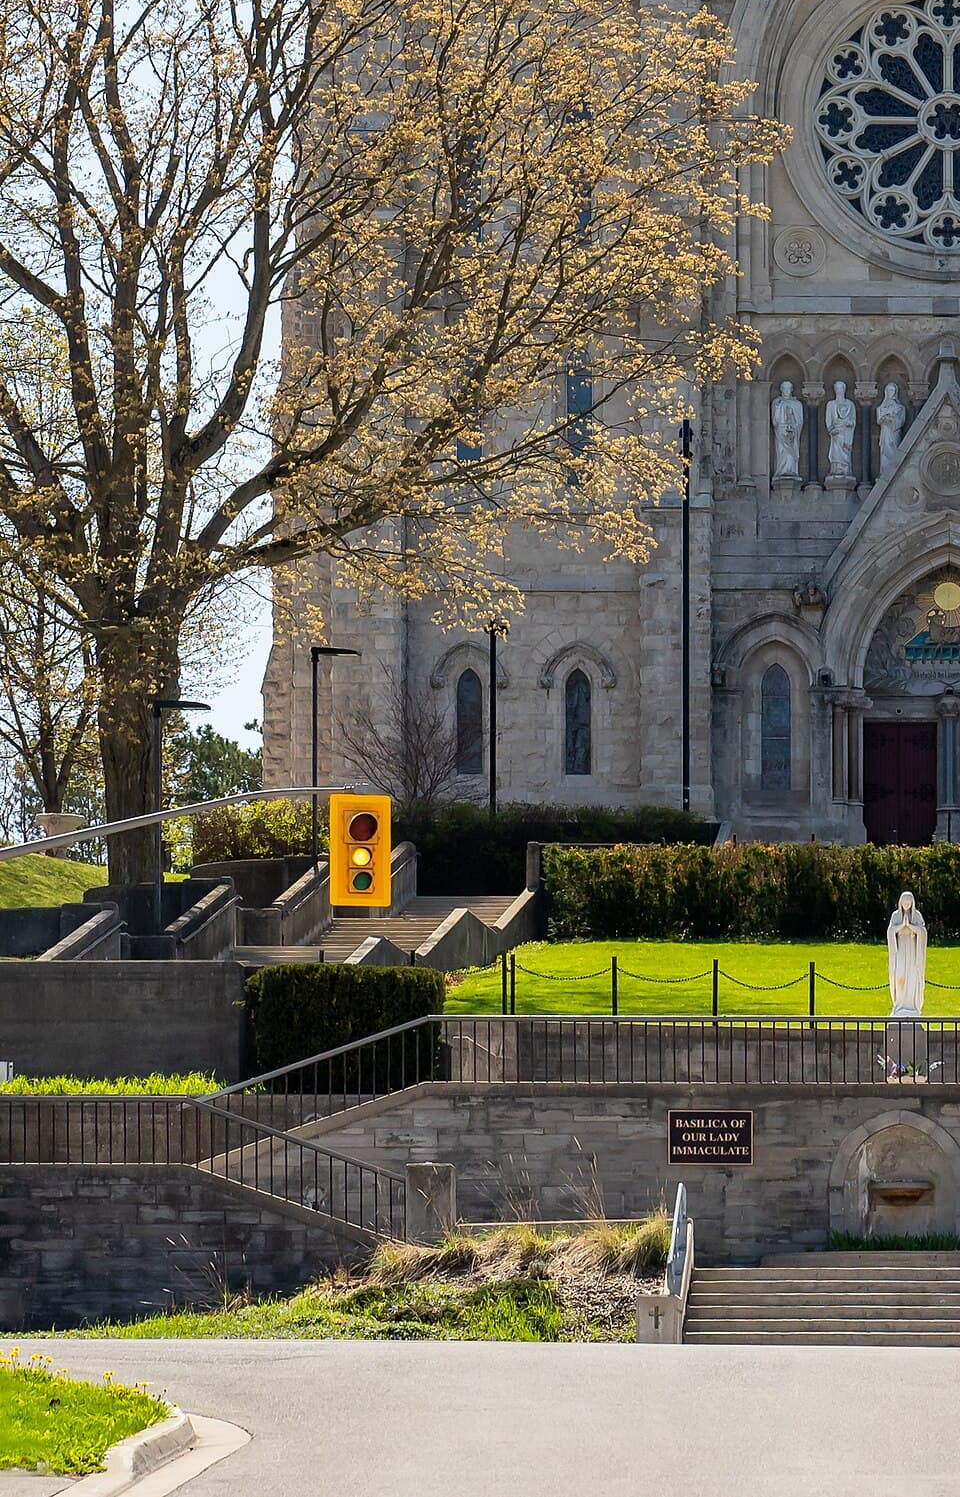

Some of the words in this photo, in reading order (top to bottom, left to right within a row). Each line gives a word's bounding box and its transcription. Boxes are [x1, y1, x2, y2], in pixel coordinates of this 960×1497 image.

[675, 1119, 728, 1128] BASILICA
[730, 1119, 747, 1128] OF
[682, 1132, 706, 1142] OUR
[709, 1132, 740, 1142] LADY
[672, 1146, 750, 1155] IMMACULATE
